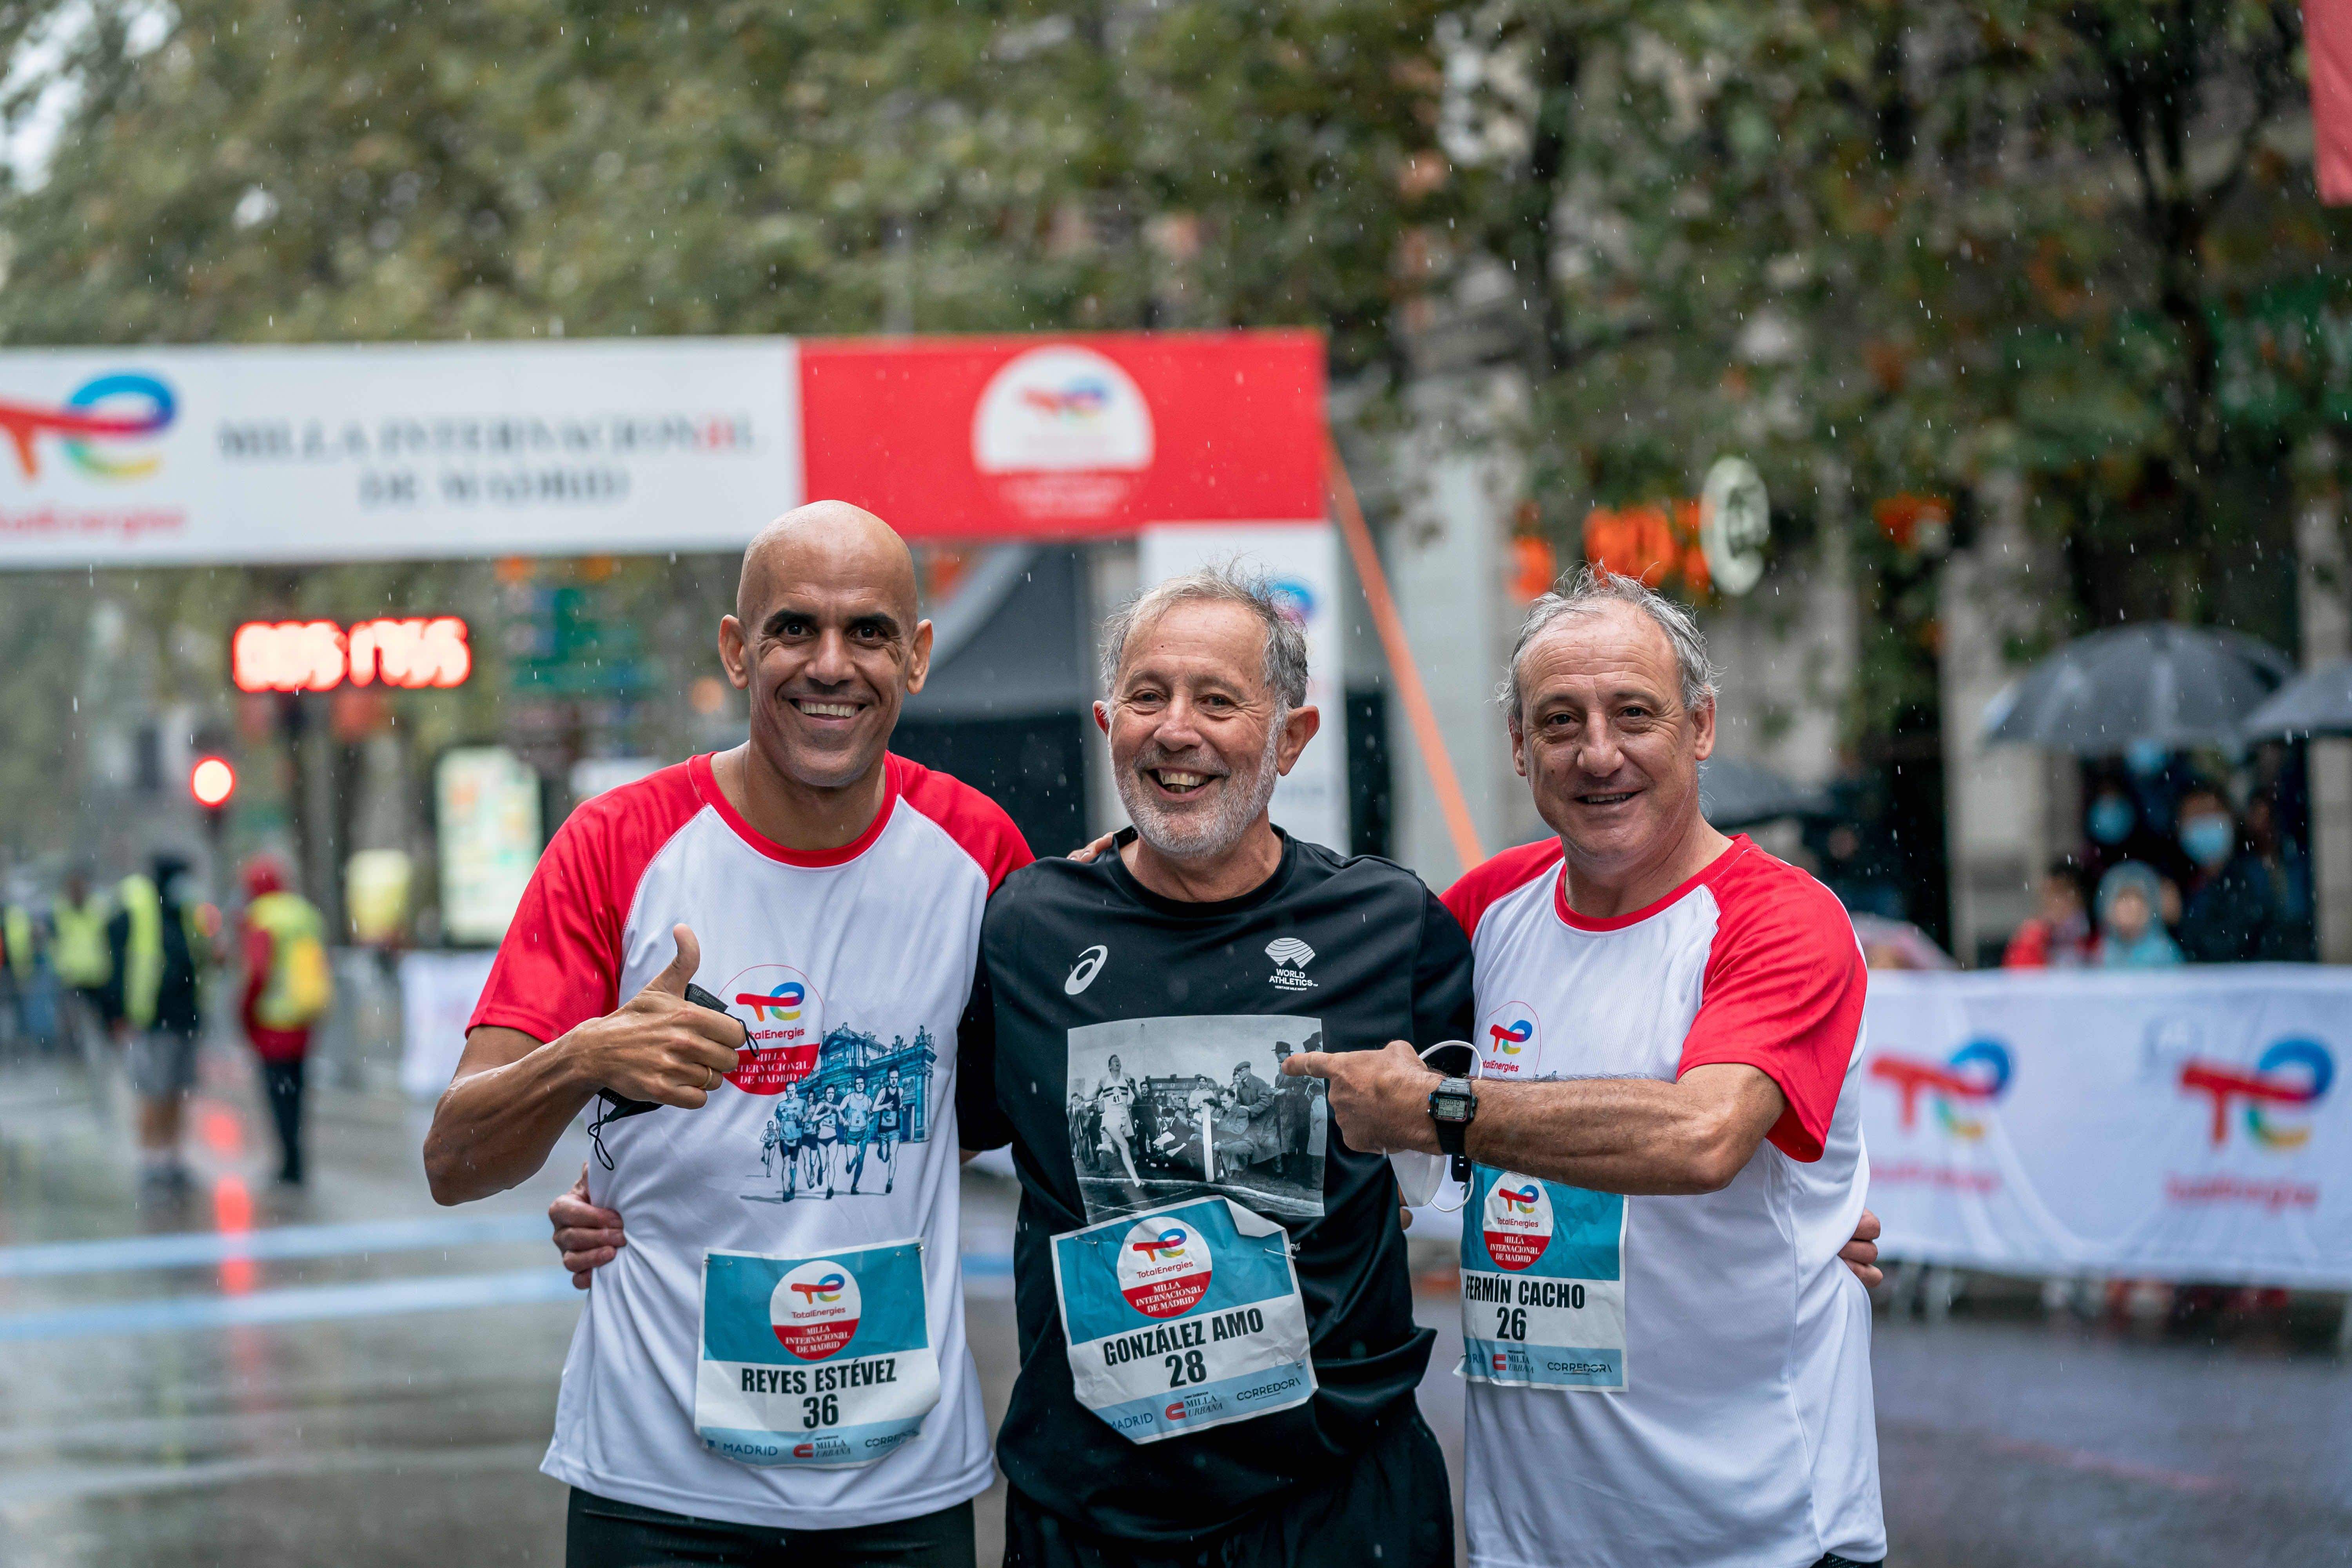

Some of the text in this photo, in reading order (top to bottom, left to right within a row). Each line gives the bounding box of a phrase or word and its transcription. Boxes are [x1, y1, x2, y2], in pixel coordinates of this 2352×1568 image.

[1276, 968, 1305, 979] WORLD
[1269, 975, 1313, 986] ATHLETICS
[750, 1027, 805, 1039] talEnergies
[756, 1052, 787, 1062] MILLA
[1483, 1059, 1519, 1073] talEnergies
[740, 1073, 797, 1084] DE MADRID
[1113, 1094, 1120, 1103] 41
[1497, 1217, 1539, 1229] TotalEnergies
[1504, 1236, 1524, 1245] MILLA
[1505, 1254, 1531, 1263] MADRID
[1136, 1261, 1194, 1279] TotalEnergies
[1153, 1281, 1181, 1293] MILLA
[1466, 1274, 1585, 1309] FERMÍN CACHO
[1147, 1296, 1195, 1313] DE MADRID
[791, 1307, 846, 1318] TotalEnergies
[1496, 1306, 1527, 1341] 26
[806, 1325, 830, 1335] MILLA
[1103, 1308, 1265, 1366] GONZÁLEZ AMO
[796, 1341, 840, 1353] DE MADRID
[1508, 1354, 1530, 1364] MILLA
[1165, 1350, 1207, 1388] 28
[742, 1358, 897, 1394] REYES ESTÉVEZ
[1186, 1394, 1217, 1408] MILLA
[803, 1393, 839, 1429] 36
[1188, 1402, 1223, 1417] URBANA
[1108, 1412, 1153, 1430] MADRID
[723, 1443, 778, 1456] MADRID
[816, 1439, 846, 1449] MILLA
